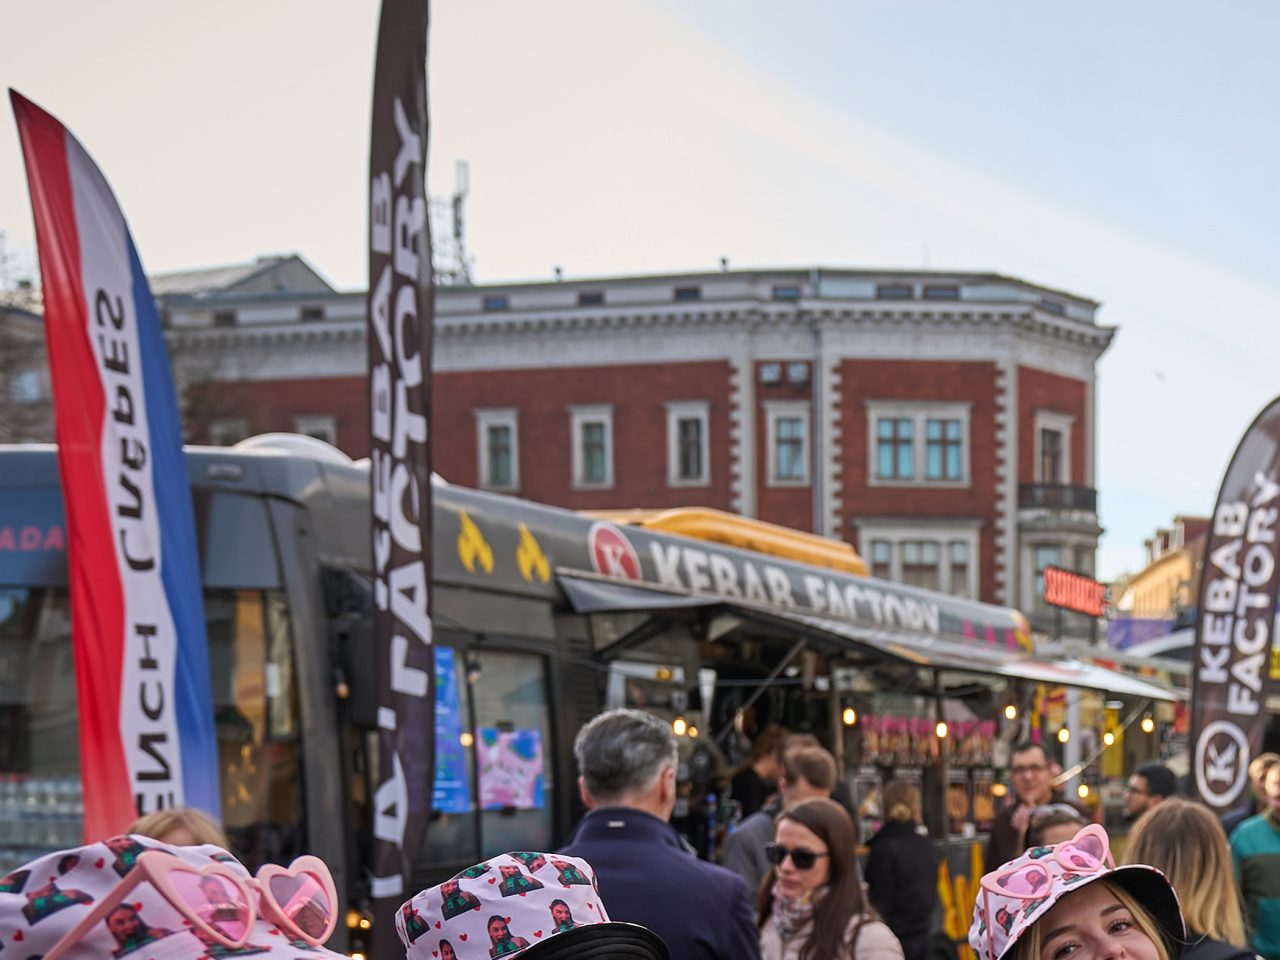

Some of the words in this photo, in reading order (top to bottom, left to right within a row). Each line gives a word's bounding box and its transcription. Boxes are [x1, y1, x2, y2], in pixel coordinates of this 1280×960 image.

[651, 541, 798, 608] KEBAB
[1199, 501, 1249, 683] KEBAB
[1206, 742, 1238, 783] K
